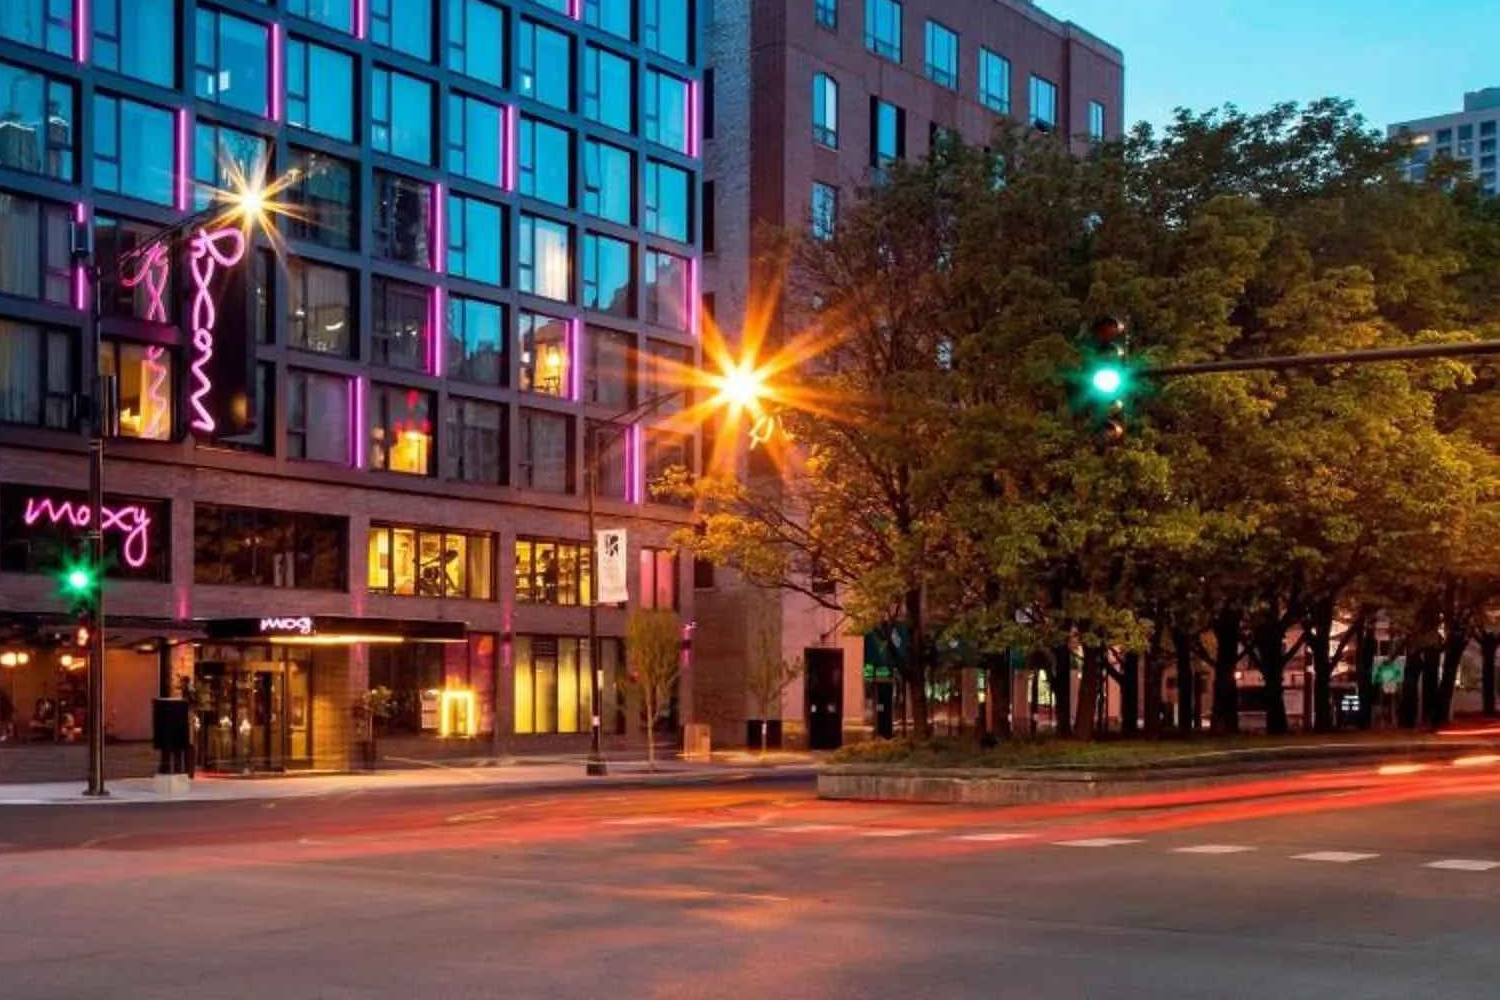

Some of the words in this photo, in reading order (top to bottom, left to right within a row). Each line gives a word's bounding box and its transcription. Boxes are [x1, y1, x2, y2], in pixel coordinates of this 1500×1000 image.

[191, 228, 245, 432] moxy
[24, 497, 151, 567] moxy
[260, 616, 312, 636] moxy
